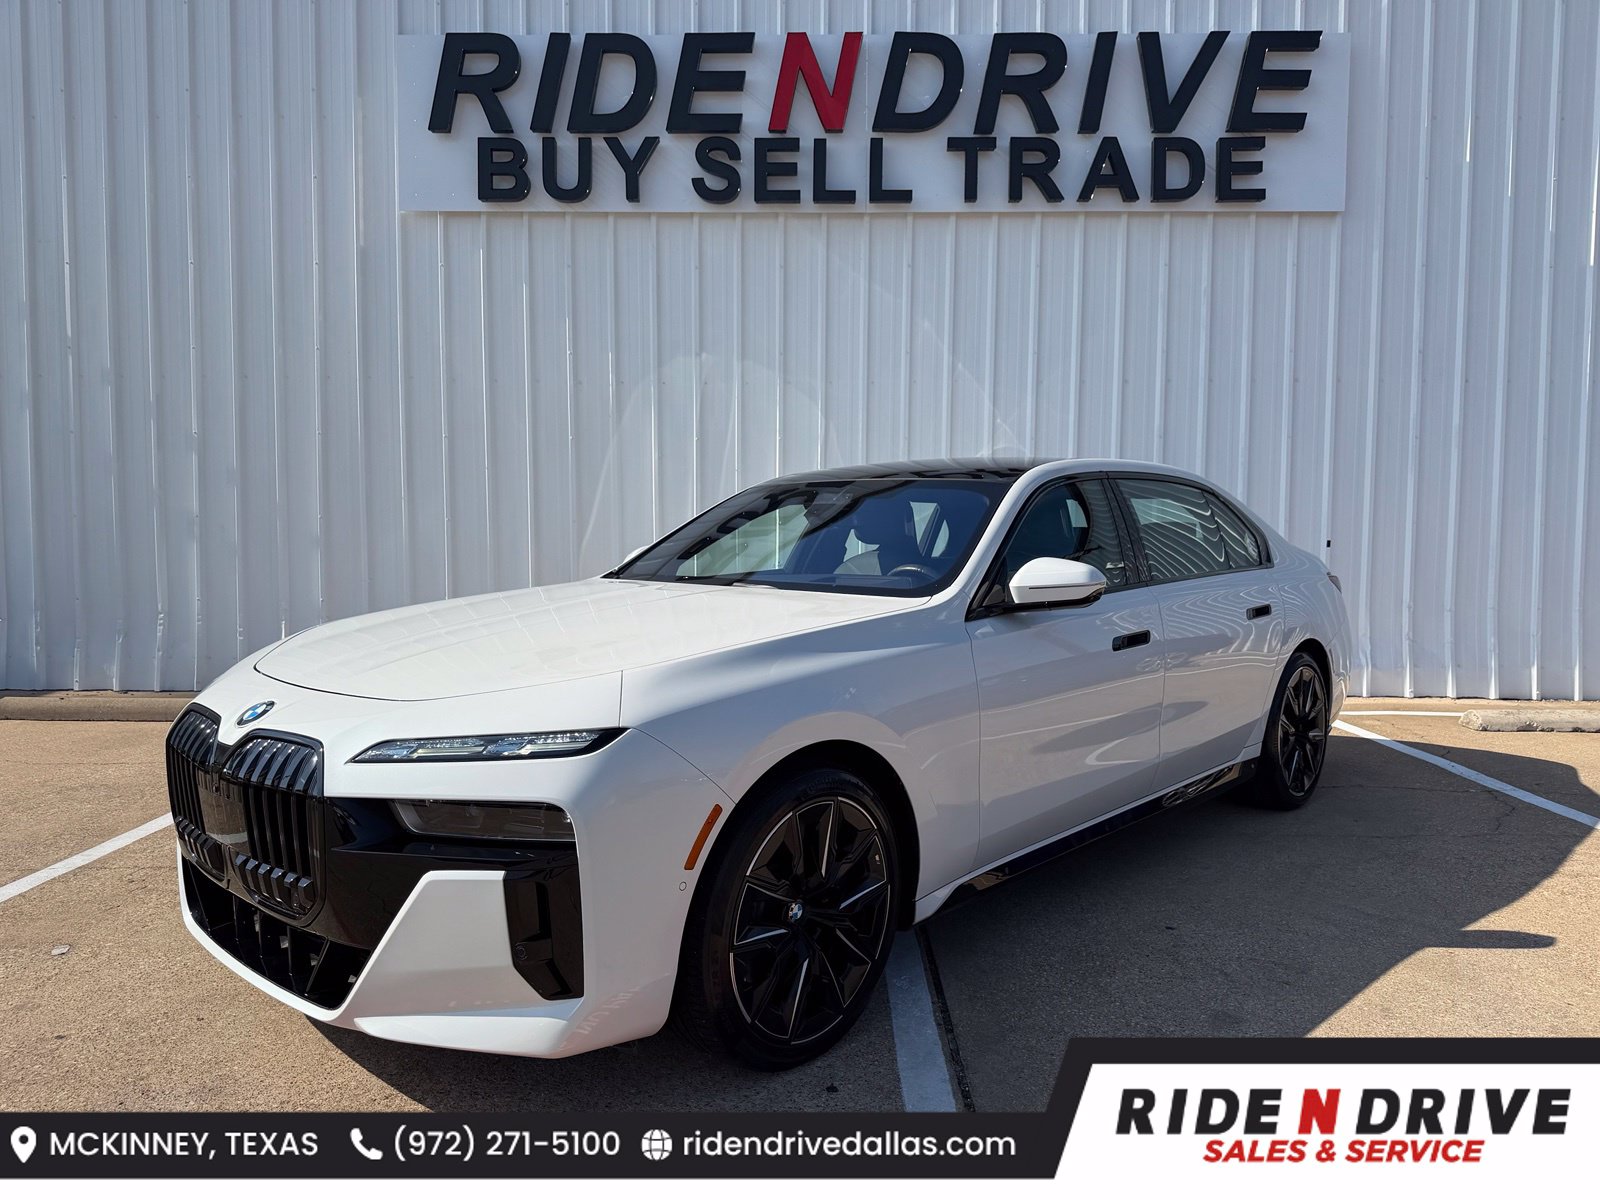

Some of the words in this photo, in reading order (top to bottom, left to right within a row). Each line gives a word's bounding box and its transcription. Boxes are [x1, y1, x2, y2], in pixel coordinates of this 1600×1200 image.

[477, 136, 660, 203] BUY
[692, 136, 913, 204] SELL
[947, 136, 1266, 203] TRADE
